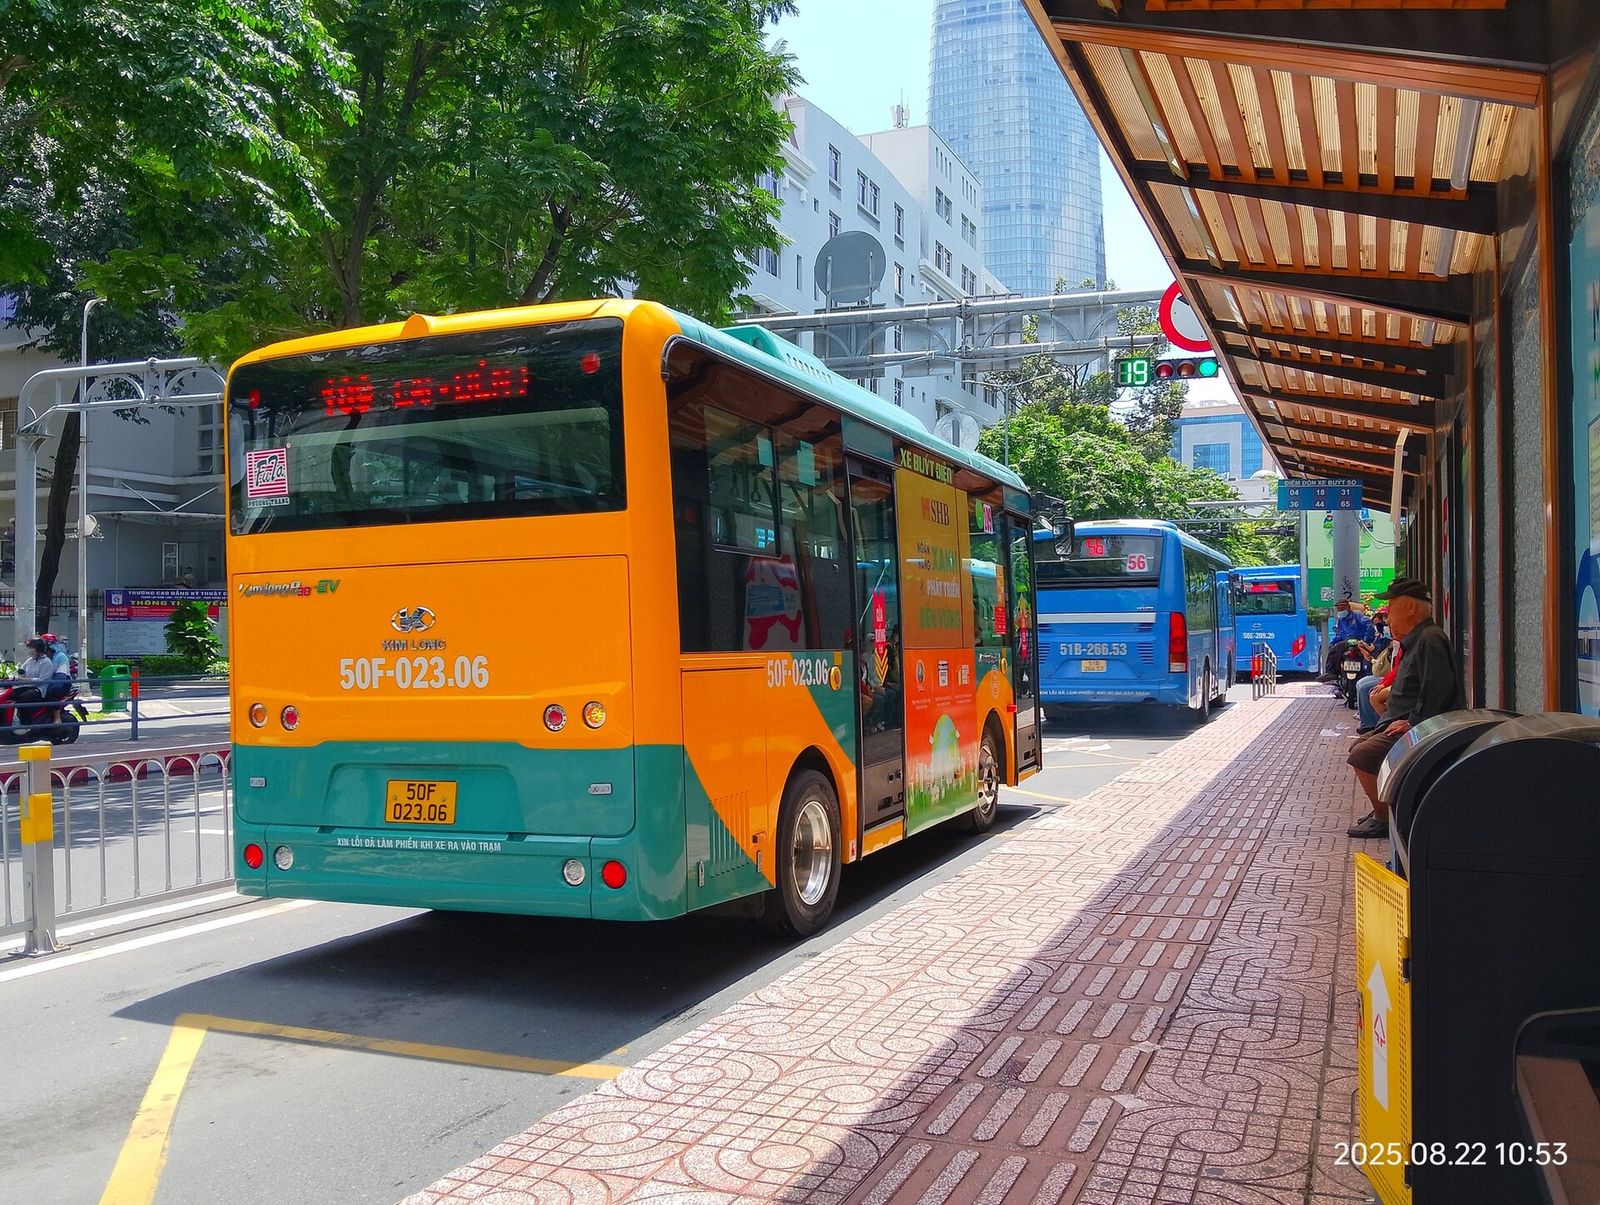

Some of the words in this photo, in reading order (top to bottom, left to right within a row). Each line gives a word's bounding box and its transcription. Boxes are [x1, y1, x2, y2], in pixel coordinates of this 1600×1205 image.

[1126, 360, 1148, 384] 19
[900, 448, 912, 467] XE
[913, 454, 934, 477] BUÝT
[930, 500, 950, 526] SHB
[1340, 500, 1350, 508] 65
[1128, 555, 1146, 570] 56
[382, 640, 407, 651] KIM
[410, 639, 447, 651] LONG
[1059, 643, 1128, 656] 51B-266.53
[339, 655, 489, 690] 50F-023.06
[767, 658, 829, 688] 50F-023.06
[406, 783, 437, 801] 50F
[393, 803, 447, 821] 023.06
[336, 837, 349, 847] XIN
[364, 837, 375, 848] ĐÃ
[377, 837, 393, 849] LÀM
[395, 837, 418, 849] PHIỀN
[420, 840, 433, 850] KHI
[435, 841, 446, 850] XE
[448, 841, 459, 851] RA
[461, 840, 477, 851] VÀO
[479, 842, 501, 853] TRẠM
